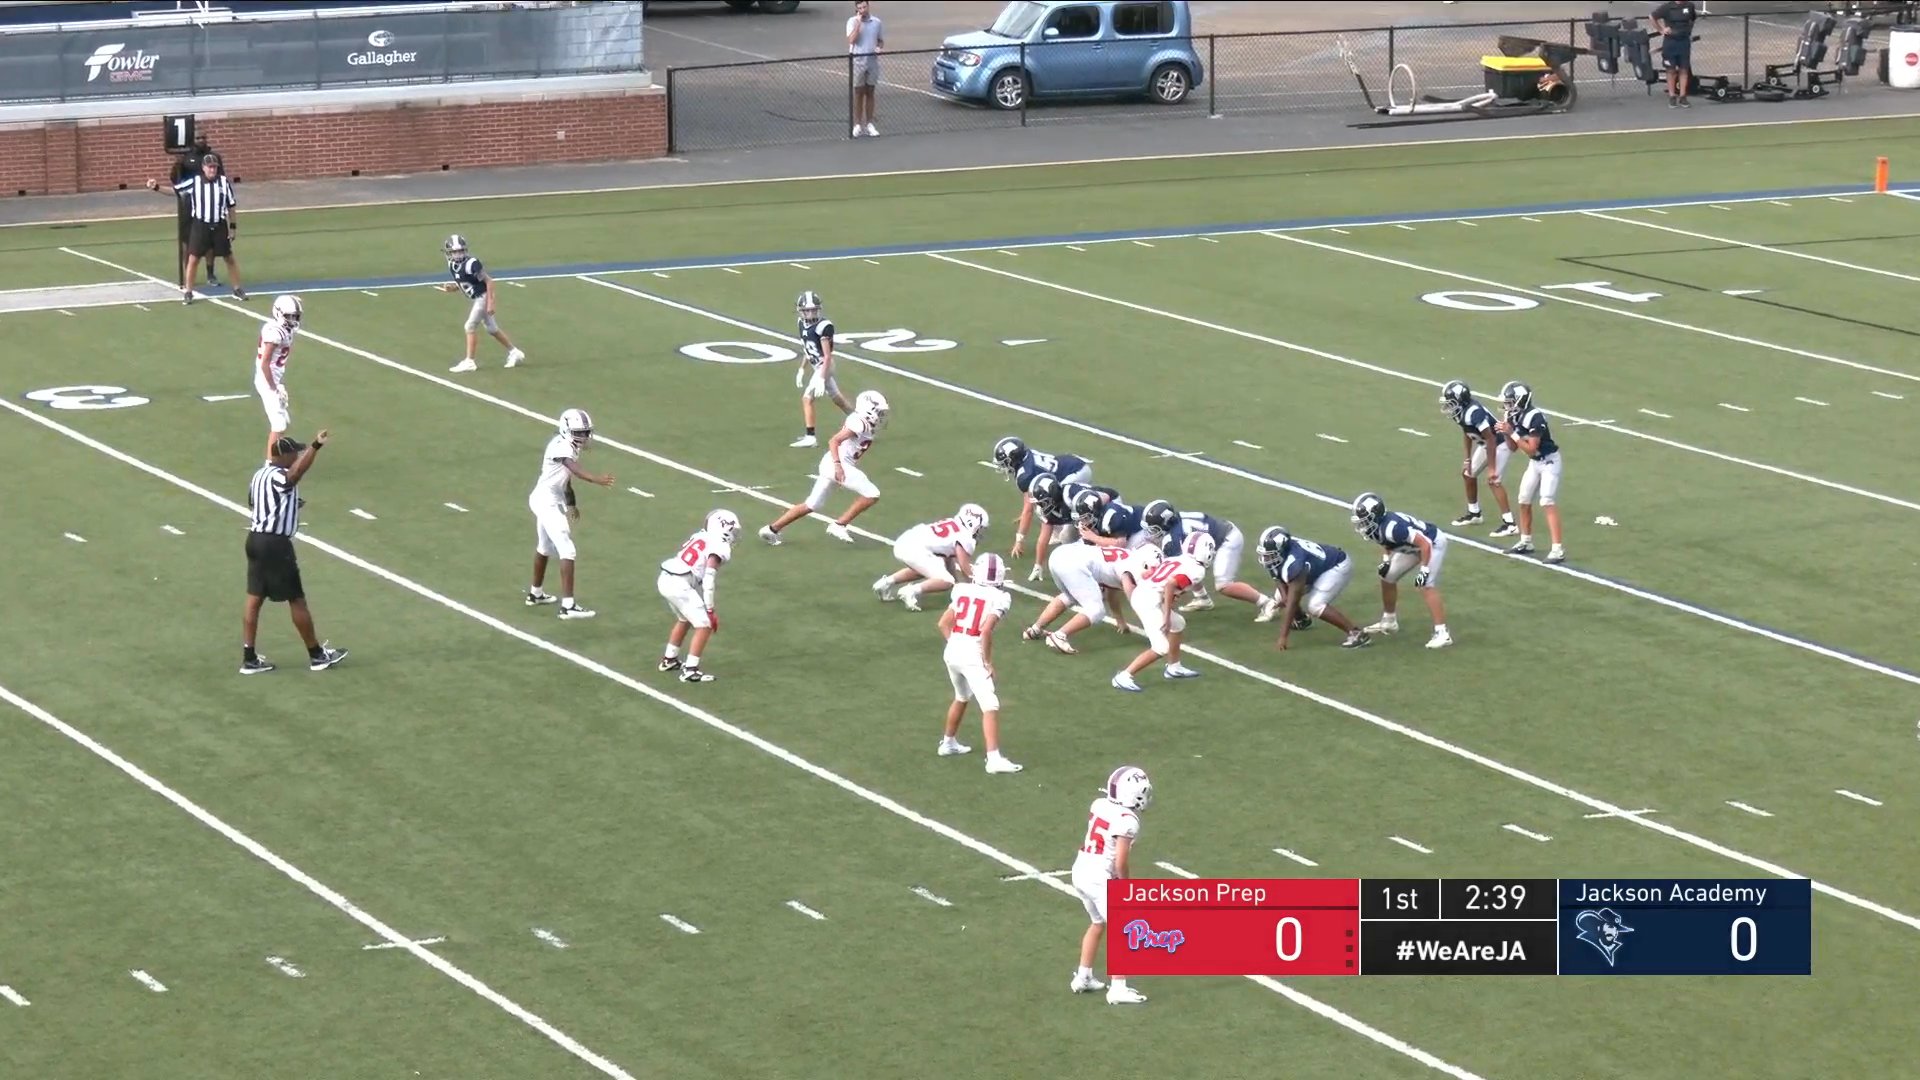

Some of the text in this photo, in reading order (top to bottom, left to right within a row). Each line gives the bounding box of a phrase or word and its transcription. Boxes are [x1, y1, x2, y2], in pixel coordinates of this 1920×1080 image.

[84, 43, 160, 82] Fowler
[347, 50, 417, 66] Gallagher
[174, 118, 186, 146] 1
[952, 595, 986, 637] 21
